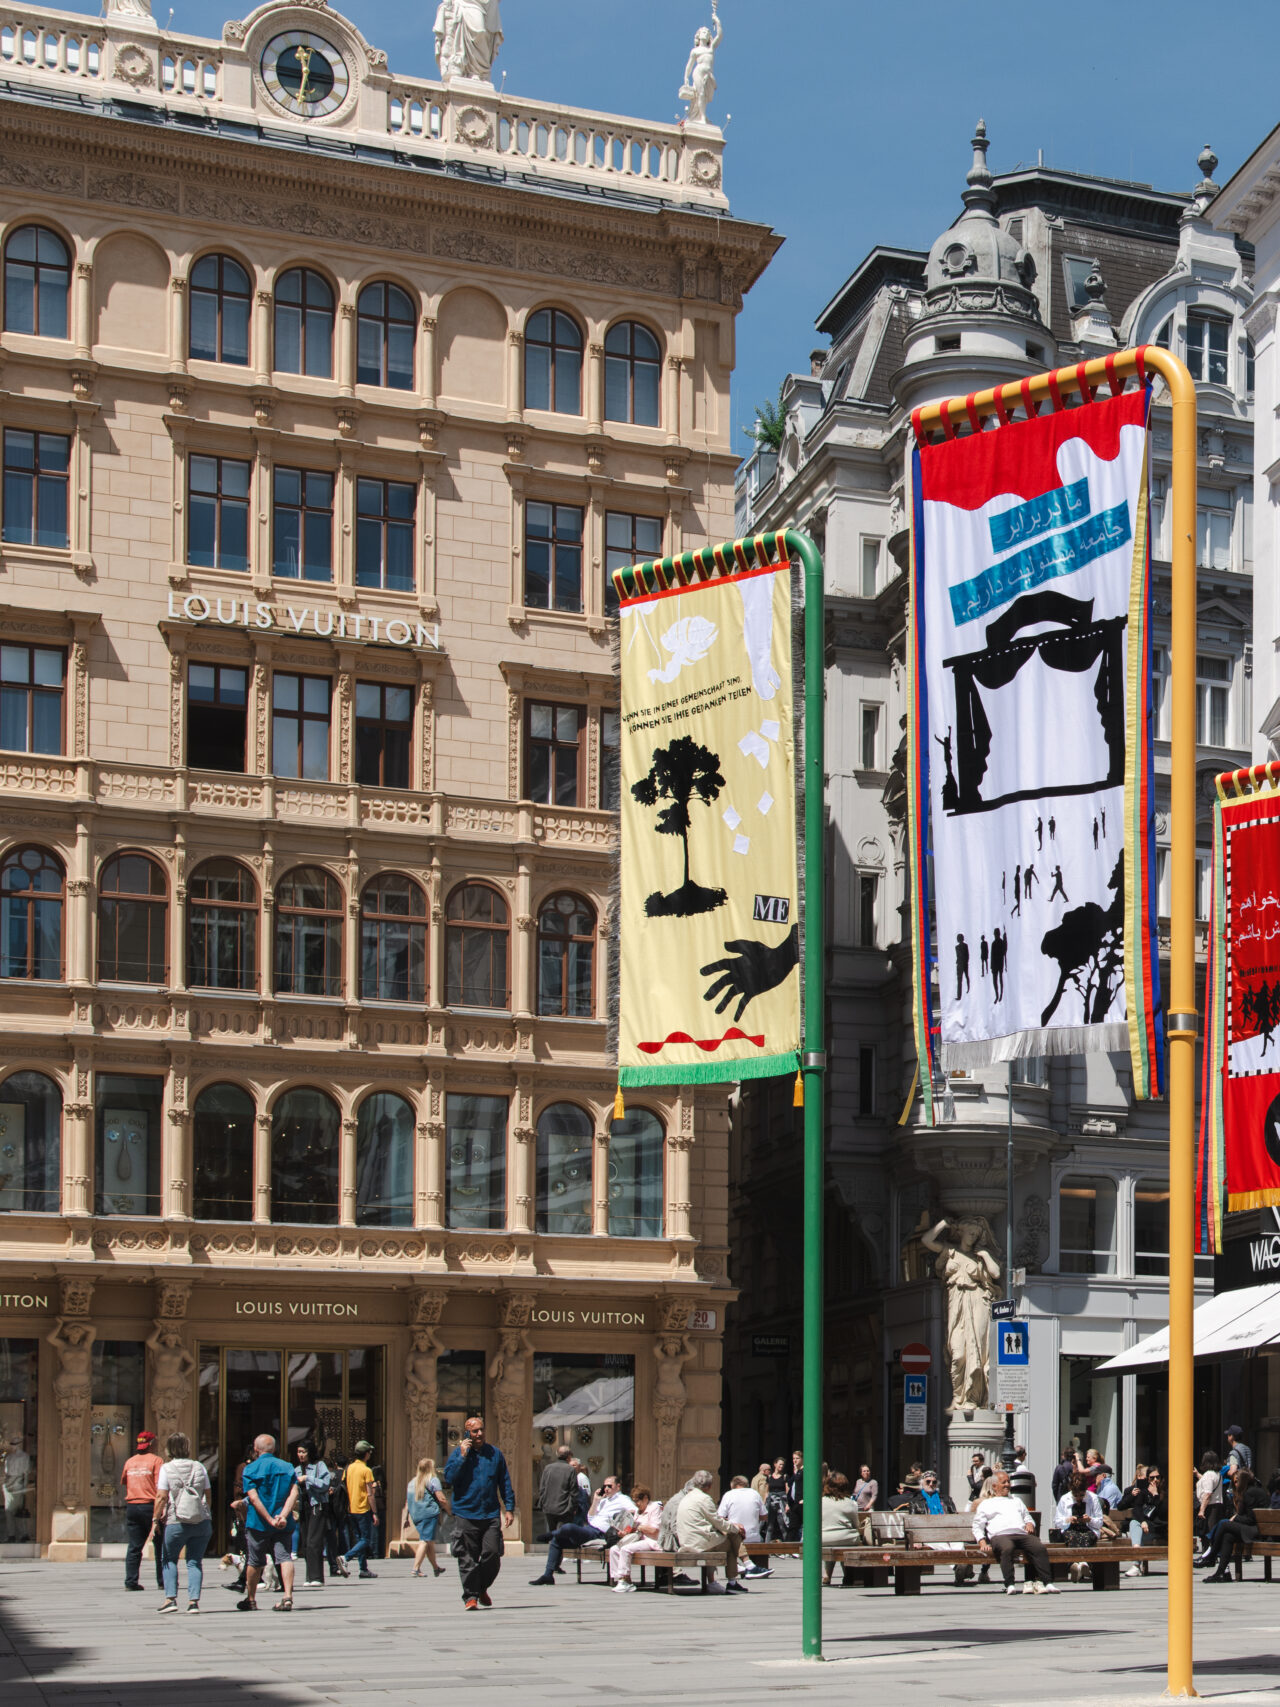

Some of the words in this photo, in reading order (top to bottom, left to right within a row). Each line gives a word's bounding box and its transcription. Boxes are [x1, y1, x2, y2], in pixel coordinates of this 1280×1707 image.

[168, 591, 272, 629] LOUIS
[287, 606, 440, 650] VUITTON
[629, 718, 660, 735] KÖNNEN
[661, 714, 672, 724] SIE
[691, 694, 727, 716] GEDANKEN
[728, 685, 752, 701] TEILEN
[640, 708, 652, 717] SIE
[653, 705, 661, 714] IN
[680, 680, 726, 705] GEMEINSCHAFT
[753, 895, 789, 923] ME
[235, 1301, 283, 1316] LOUIS
[289, 1302, 359, 1317] VUITTON
[531, 1309, 576, 1323] LOUIS
[580, 1311, 645, 1326] VUITTON
[694, 1311, 708, 1323] 20
